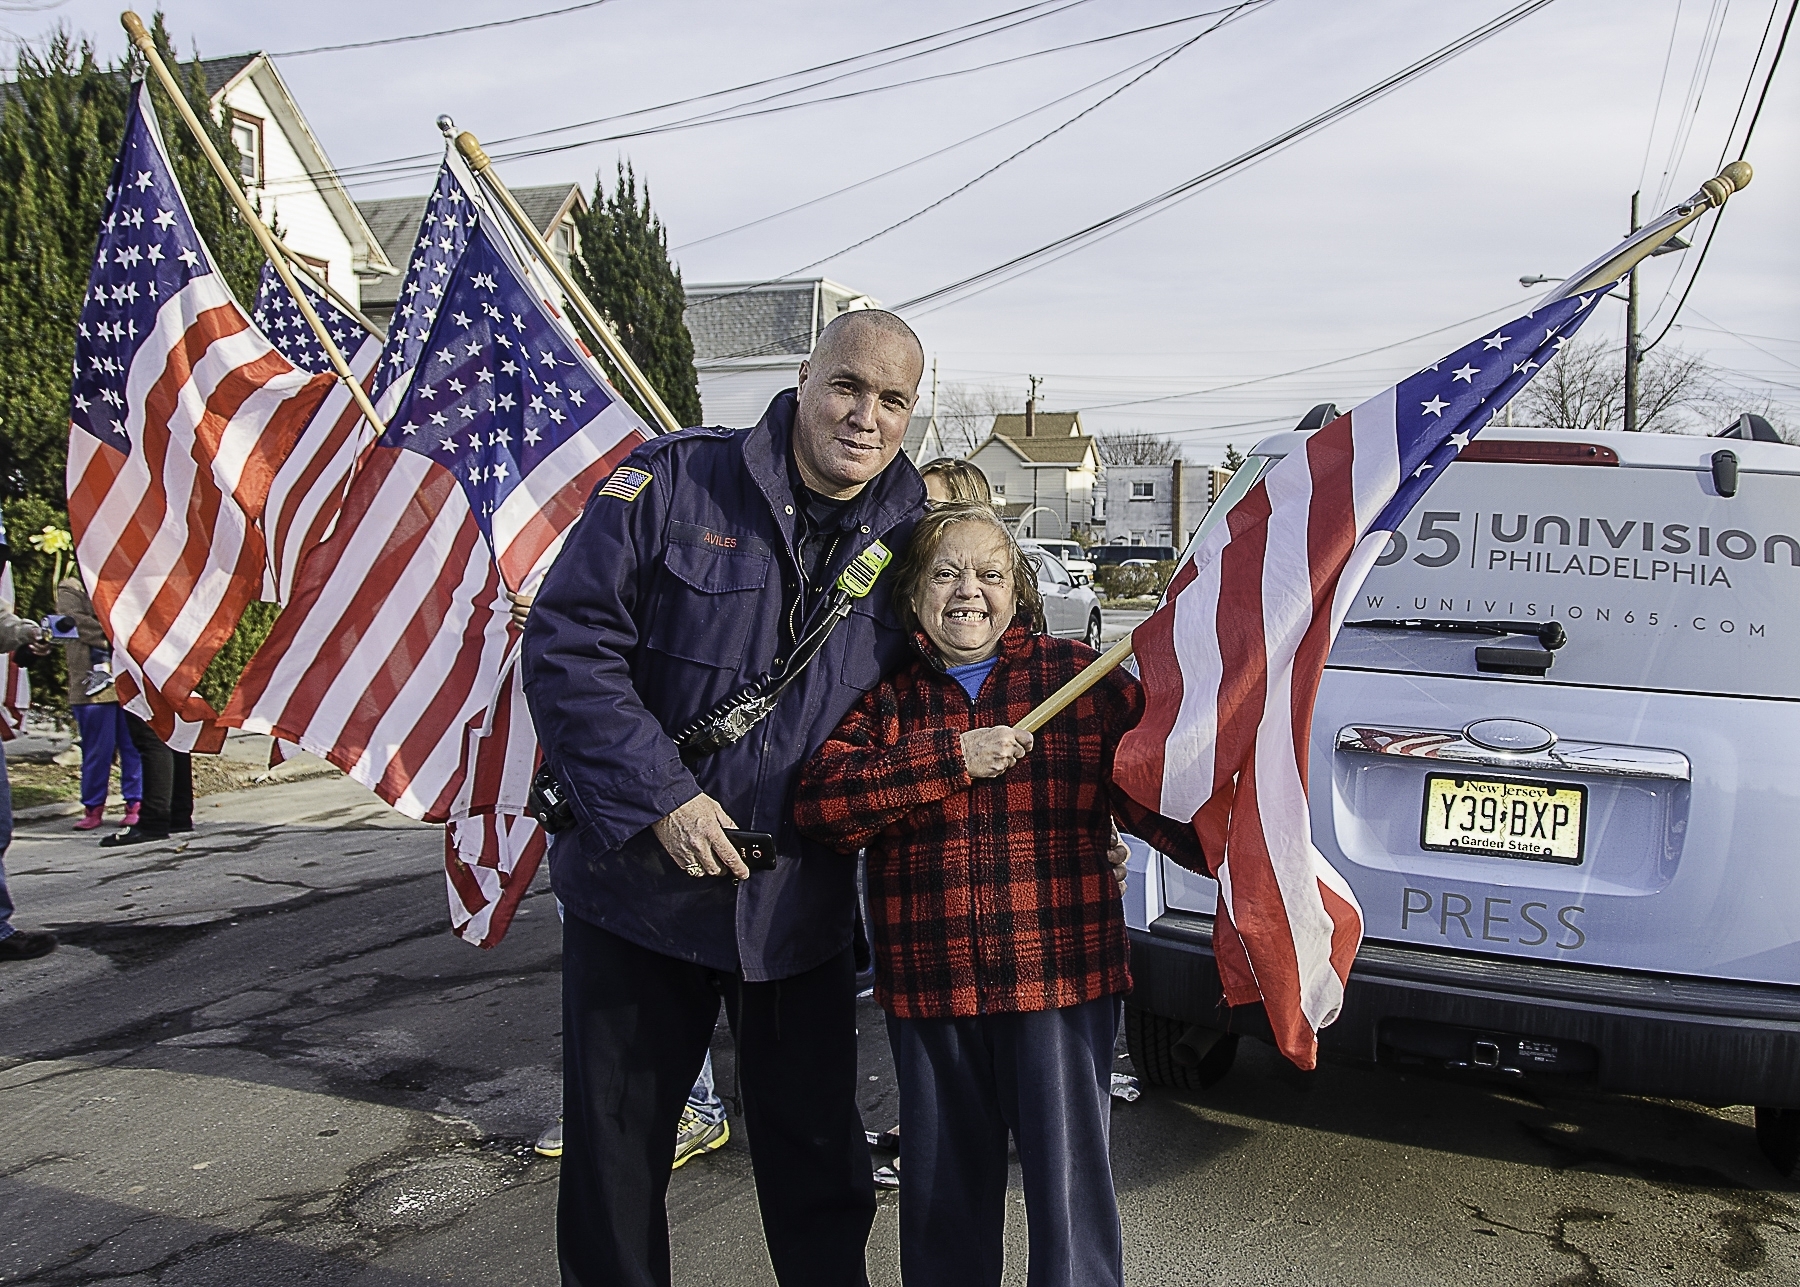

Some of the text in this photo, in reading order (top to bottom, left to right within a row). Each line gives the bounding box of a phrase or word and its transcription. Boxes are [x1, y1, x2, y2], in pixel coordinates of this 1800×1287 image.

[704, 532, 737, 548] AVILES
[1491, 513, 1800, 567] UNIVISION
[1489, 549, 1732, 589] PHILADELPHIA
[1466, 780, 1499, 794] New
[1501, 783, 1545, 800] Jersey
[1461, 835, 1541, 853] Garden State
[1401, 887, 1586, 950] PRESS
